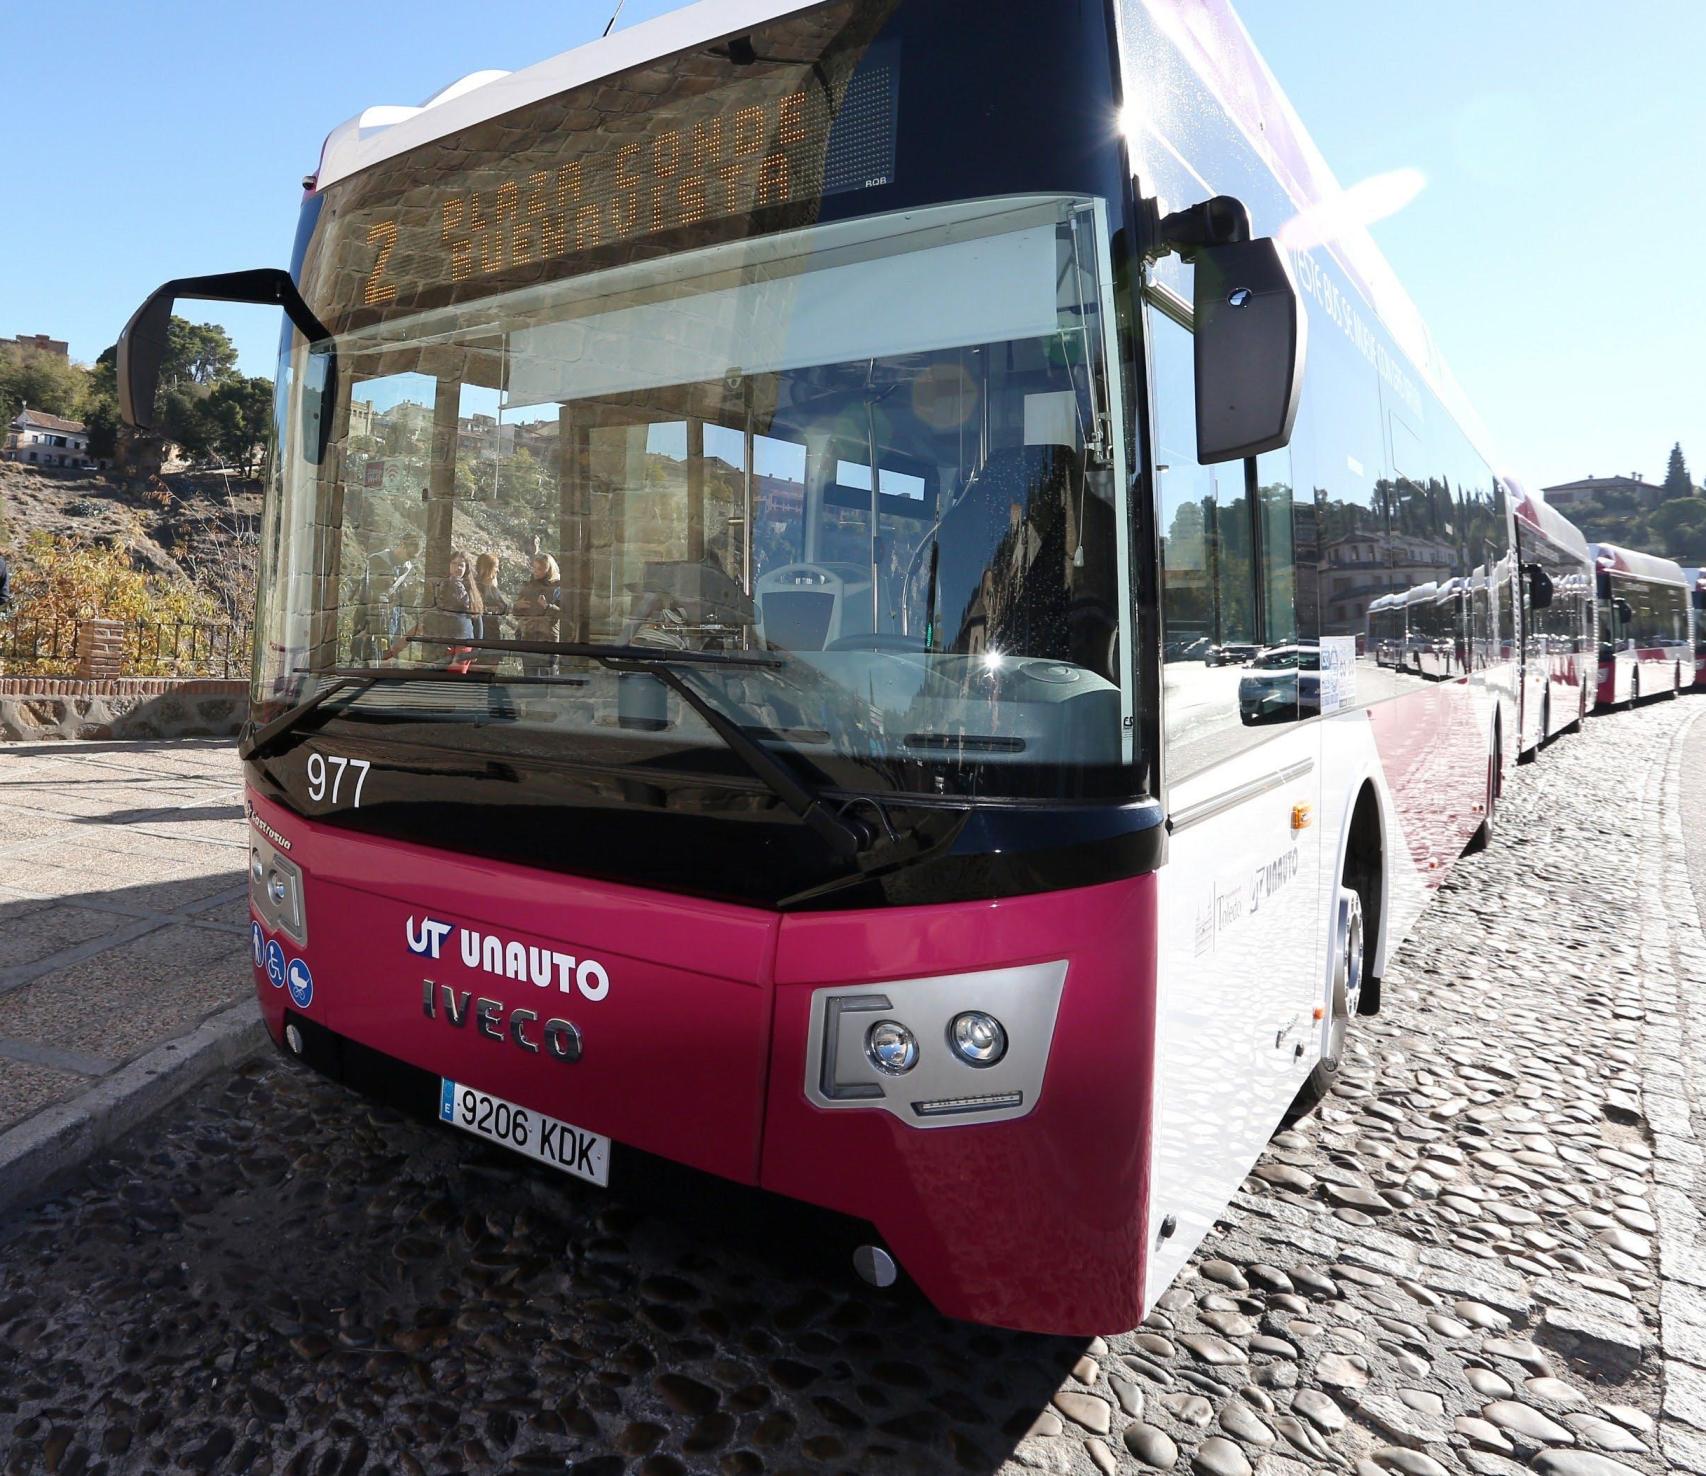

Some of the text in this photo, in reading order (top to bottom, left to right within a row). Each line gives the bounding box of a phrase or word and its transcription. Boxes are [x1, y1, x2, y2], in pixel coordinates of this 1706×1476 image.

[442, 92, 805, 240] PLAZA CONDE
[452, 152, 789, 281] BUENAVISTA
[364, 220, 397, 304] 2
[306, 753, 371, 809] 977
[460, 928, 610, 1002] UNAUTO
[423, 979, 584, 1064] IVECO
[444, 1103, 451, 1114] E
[462, 1090, 597, 1177] 9206 KDK
